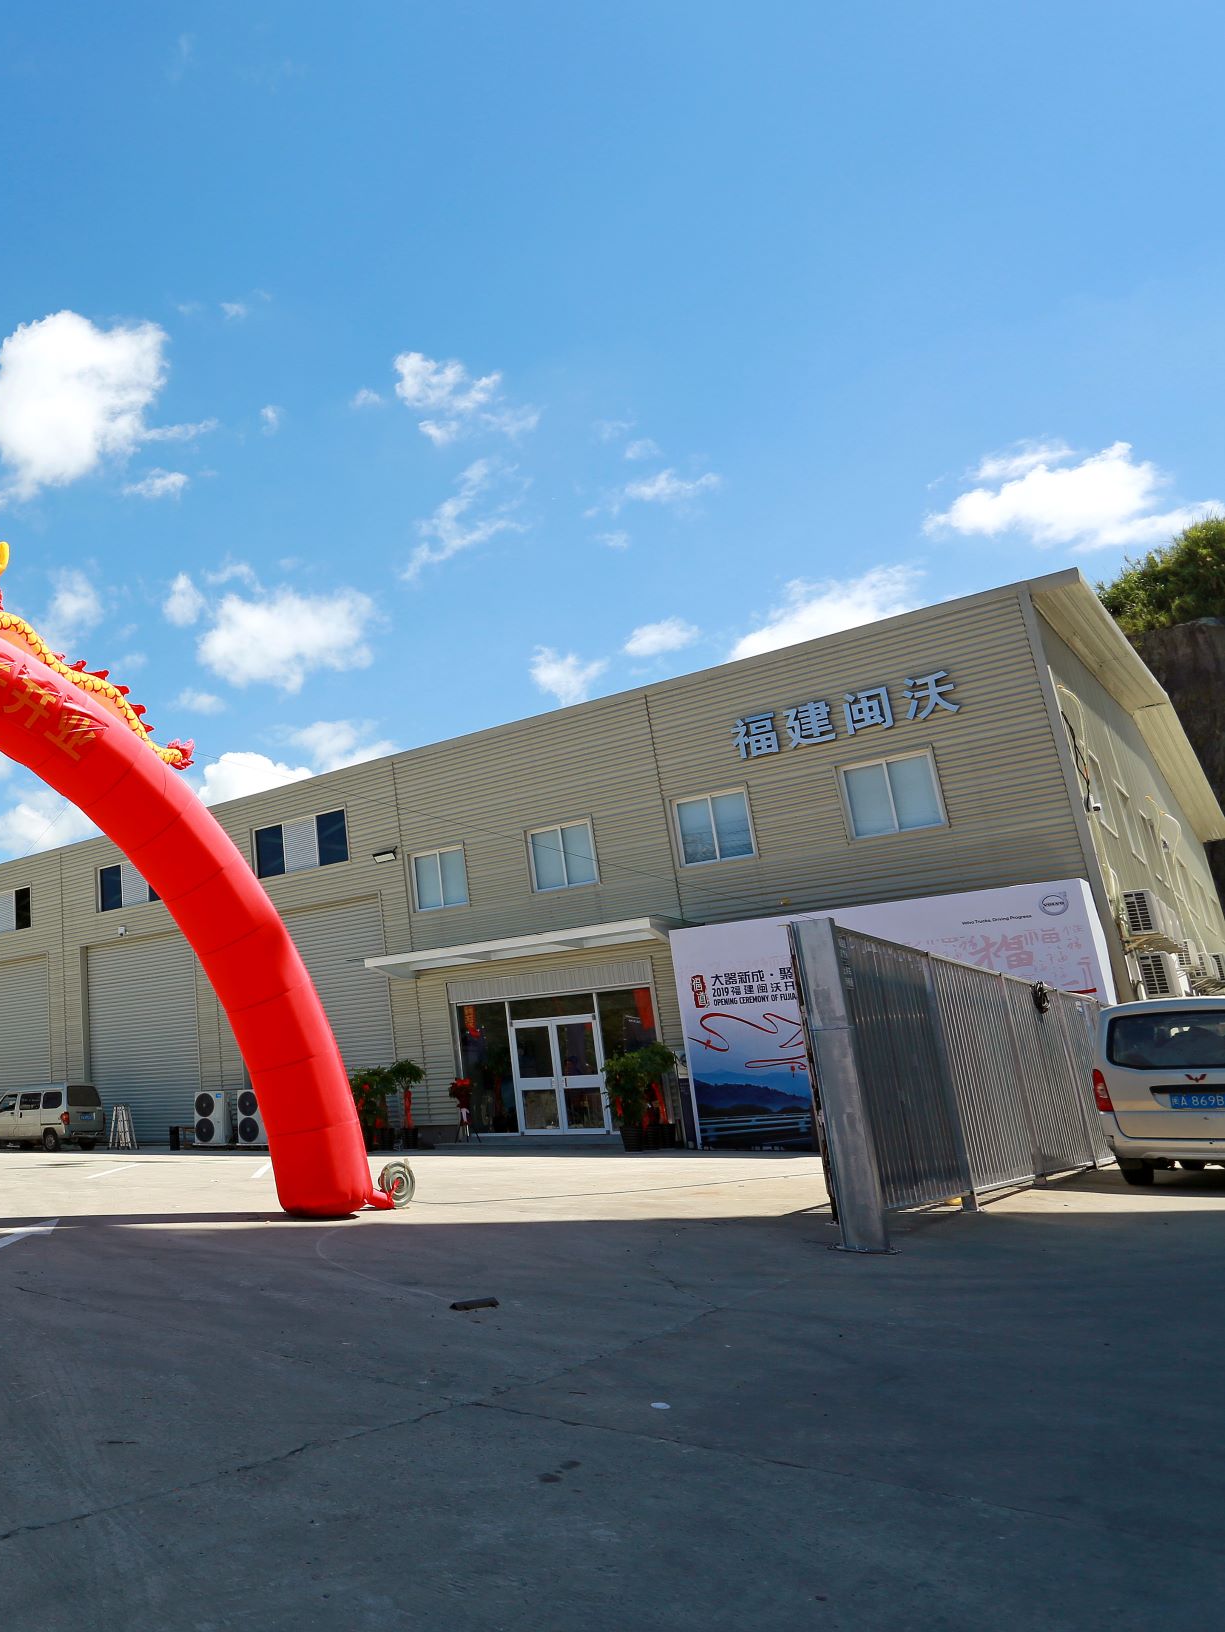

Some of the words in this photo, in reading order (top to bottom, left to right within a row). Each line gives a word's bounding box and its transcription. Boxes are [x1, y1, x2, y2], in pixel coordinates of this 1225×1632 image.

[730, 670, 960, 759] 福建闽沃
[992, 915, 1010, 923] Driving
[713, 998, 738, 1007] OPENING
[739, 994, 770, 1005] CEREMONY
[770, 993, 780, 1002] OF
